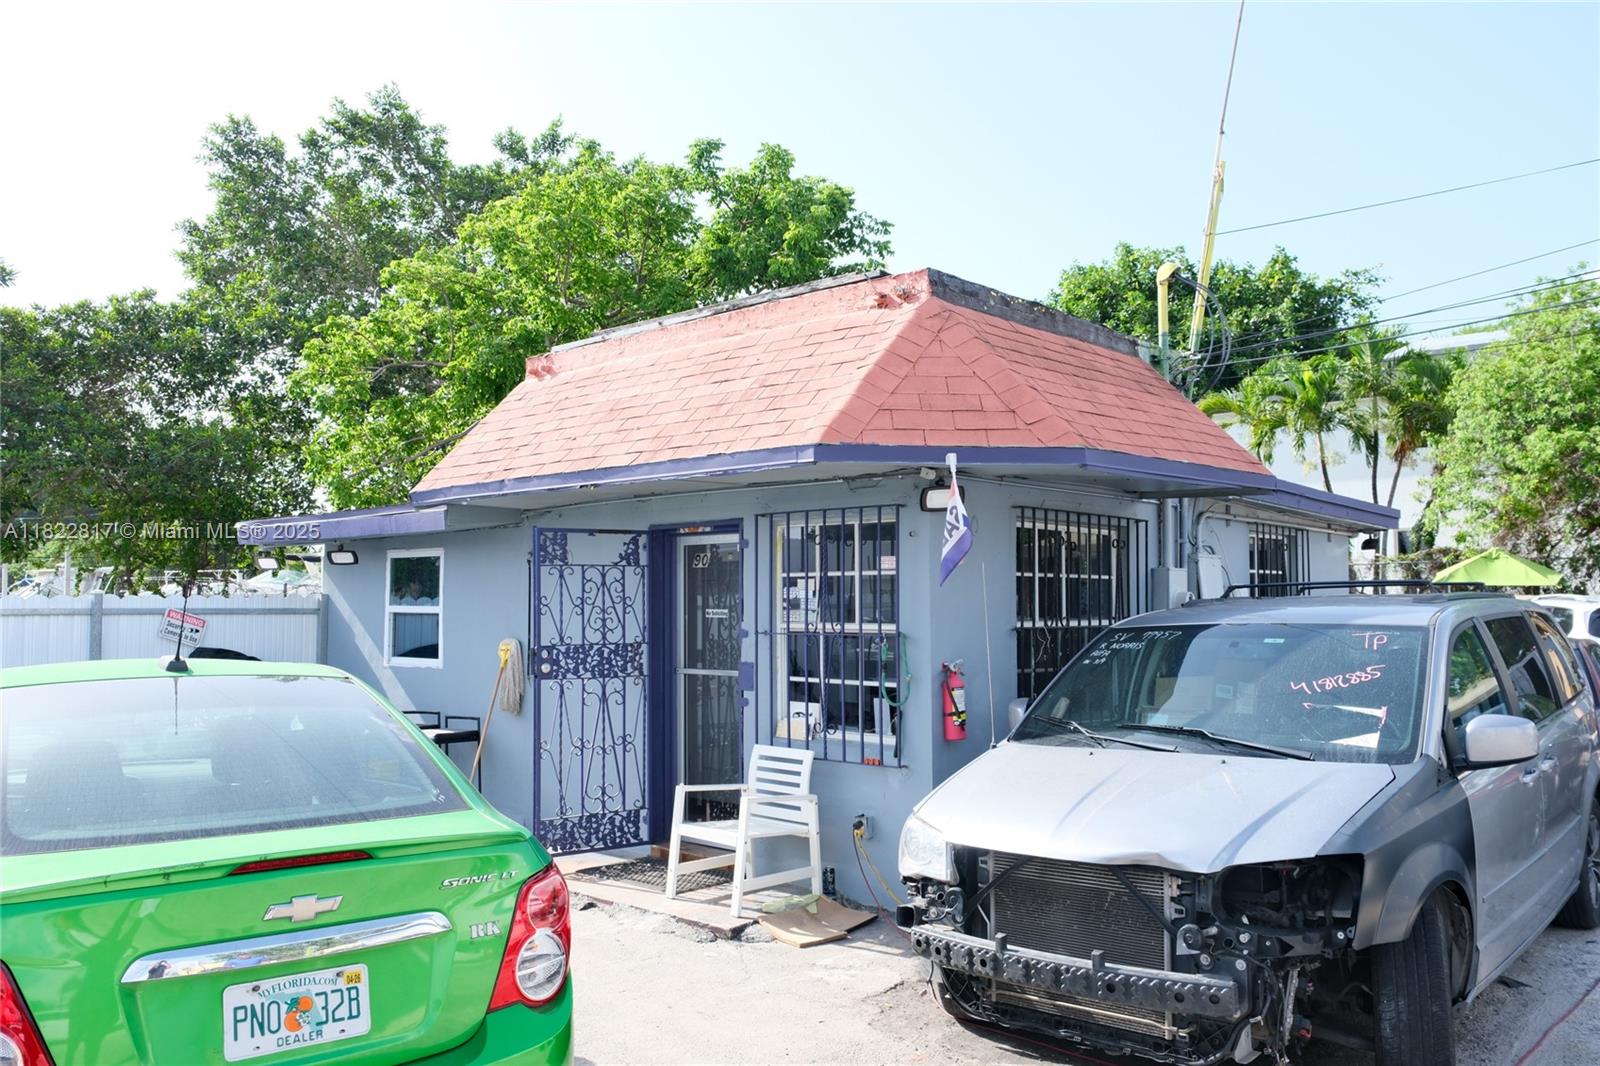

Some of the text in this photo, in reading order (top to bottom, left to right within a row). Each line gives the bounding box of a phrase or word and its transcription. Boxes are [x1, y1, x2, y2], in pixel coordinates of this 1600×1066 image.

[694, 554, 709, 567] 90
[441, 870, 519, 888] SONIC LT
[276, 1029, 324, 1048] DEALER
